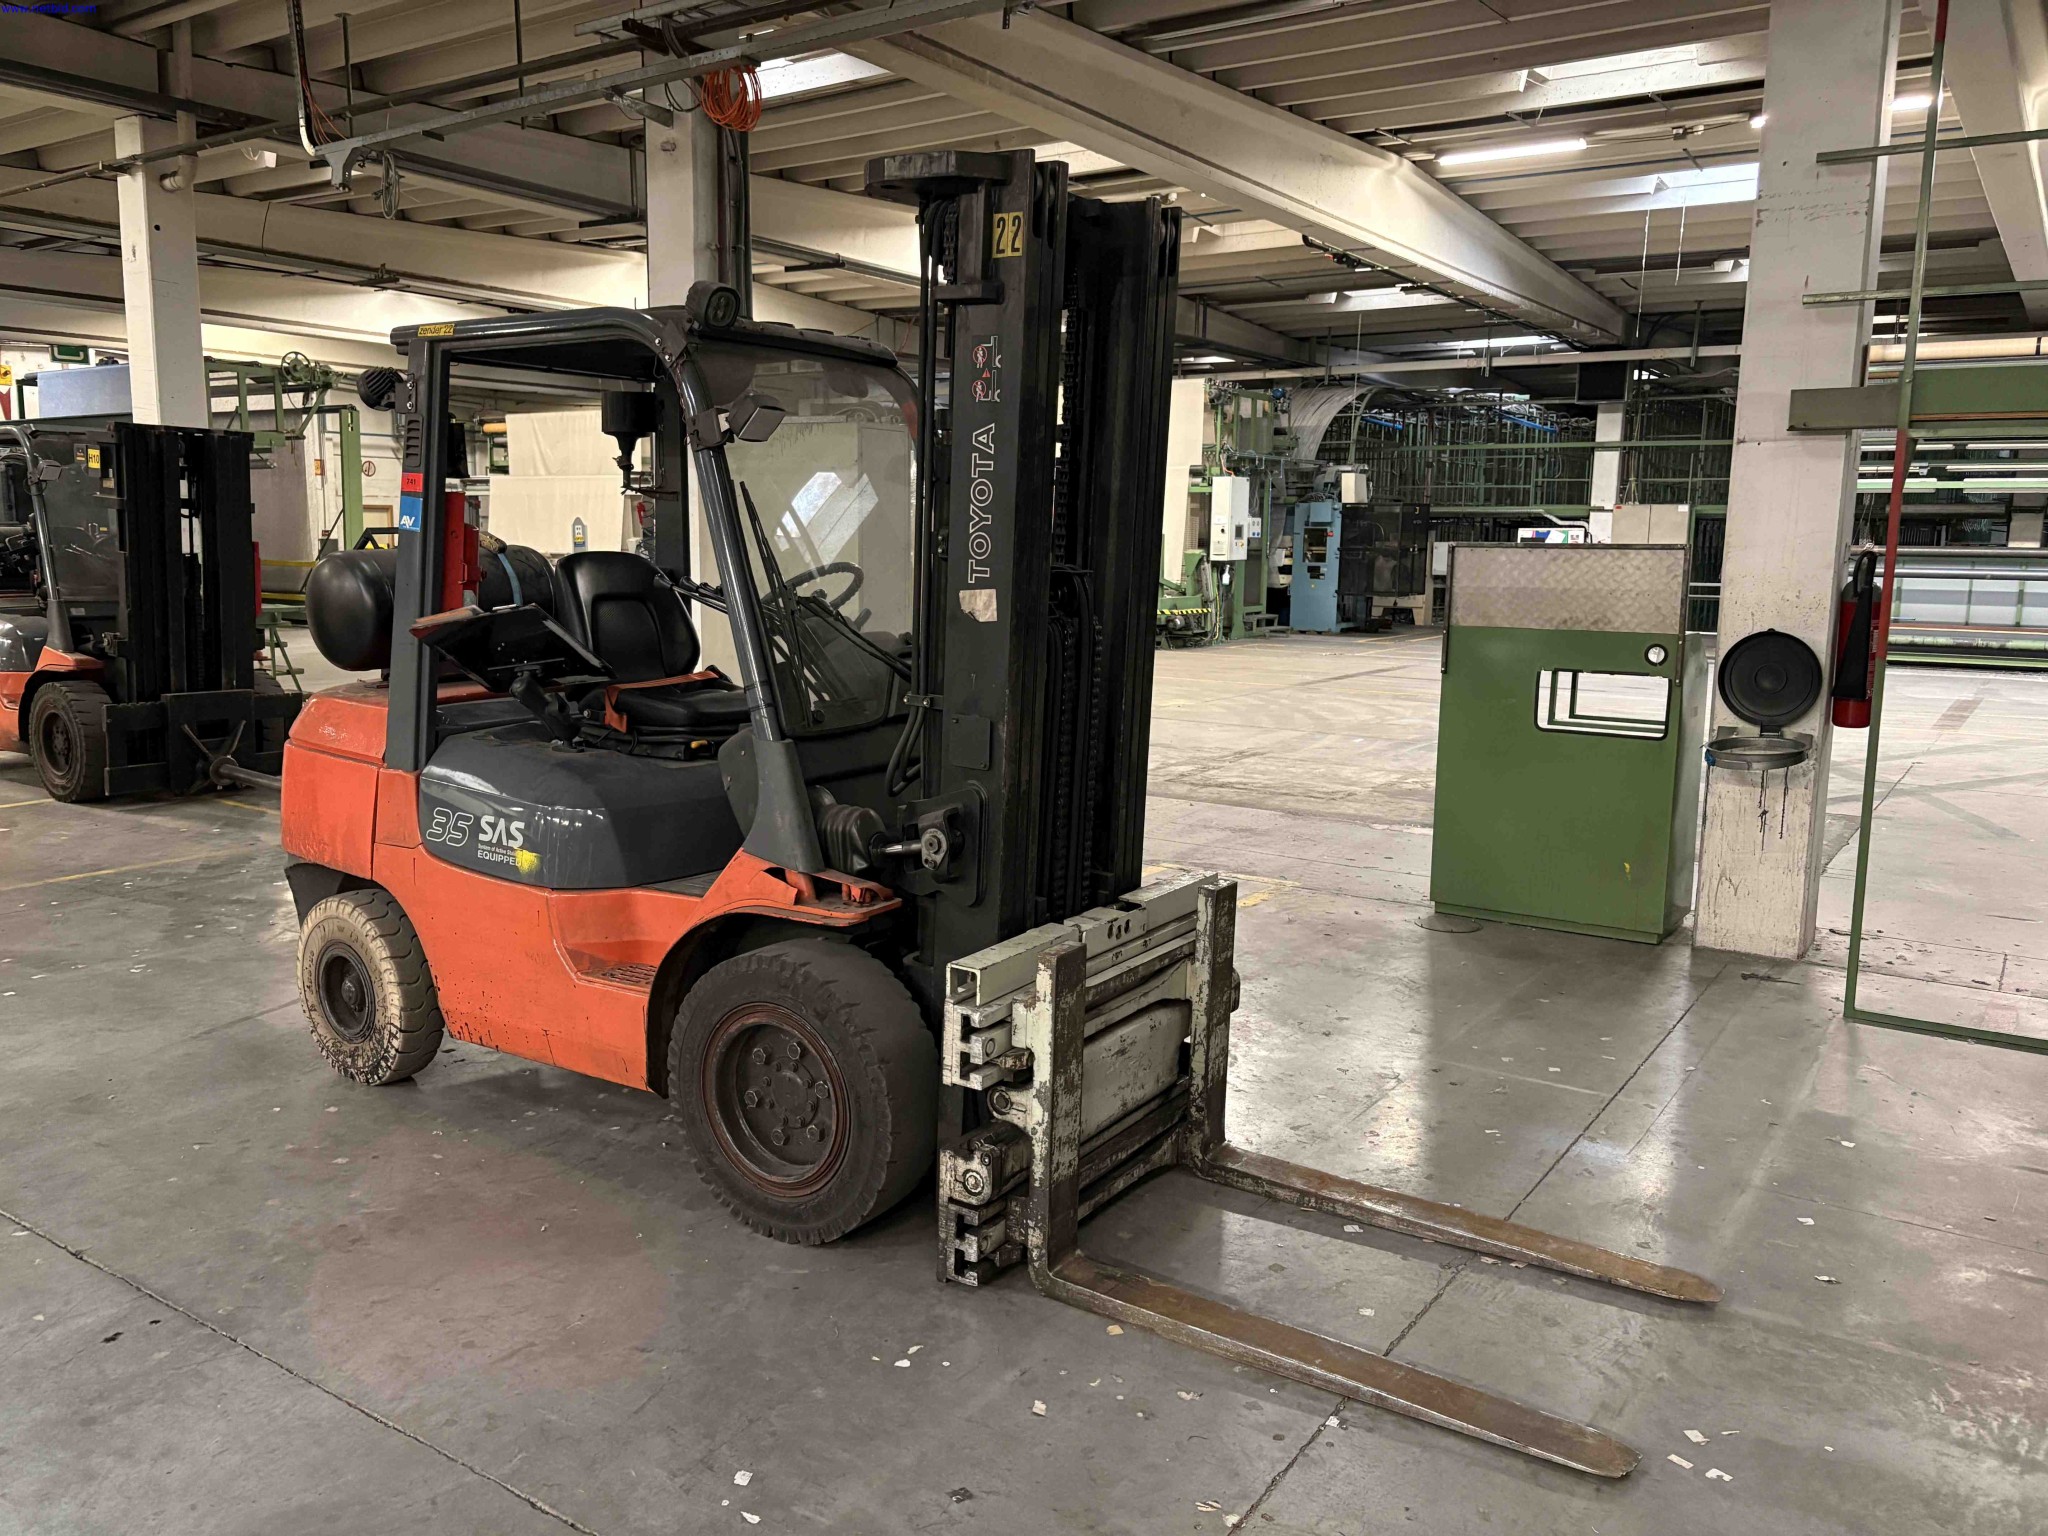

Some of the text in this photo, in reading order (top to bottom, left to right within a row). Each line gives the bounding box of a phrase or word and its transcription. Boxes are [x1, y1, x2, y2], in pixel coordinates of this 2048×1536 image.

[996, 215, 1021, 254] 22
[444, 324, 452, 334] 22
[88, 453, 100, 464] H10
[968, 423, 995, 583] TOYOTA
[426, 807, 474, 847] 35
[478, 815, 525, 849] SAS
